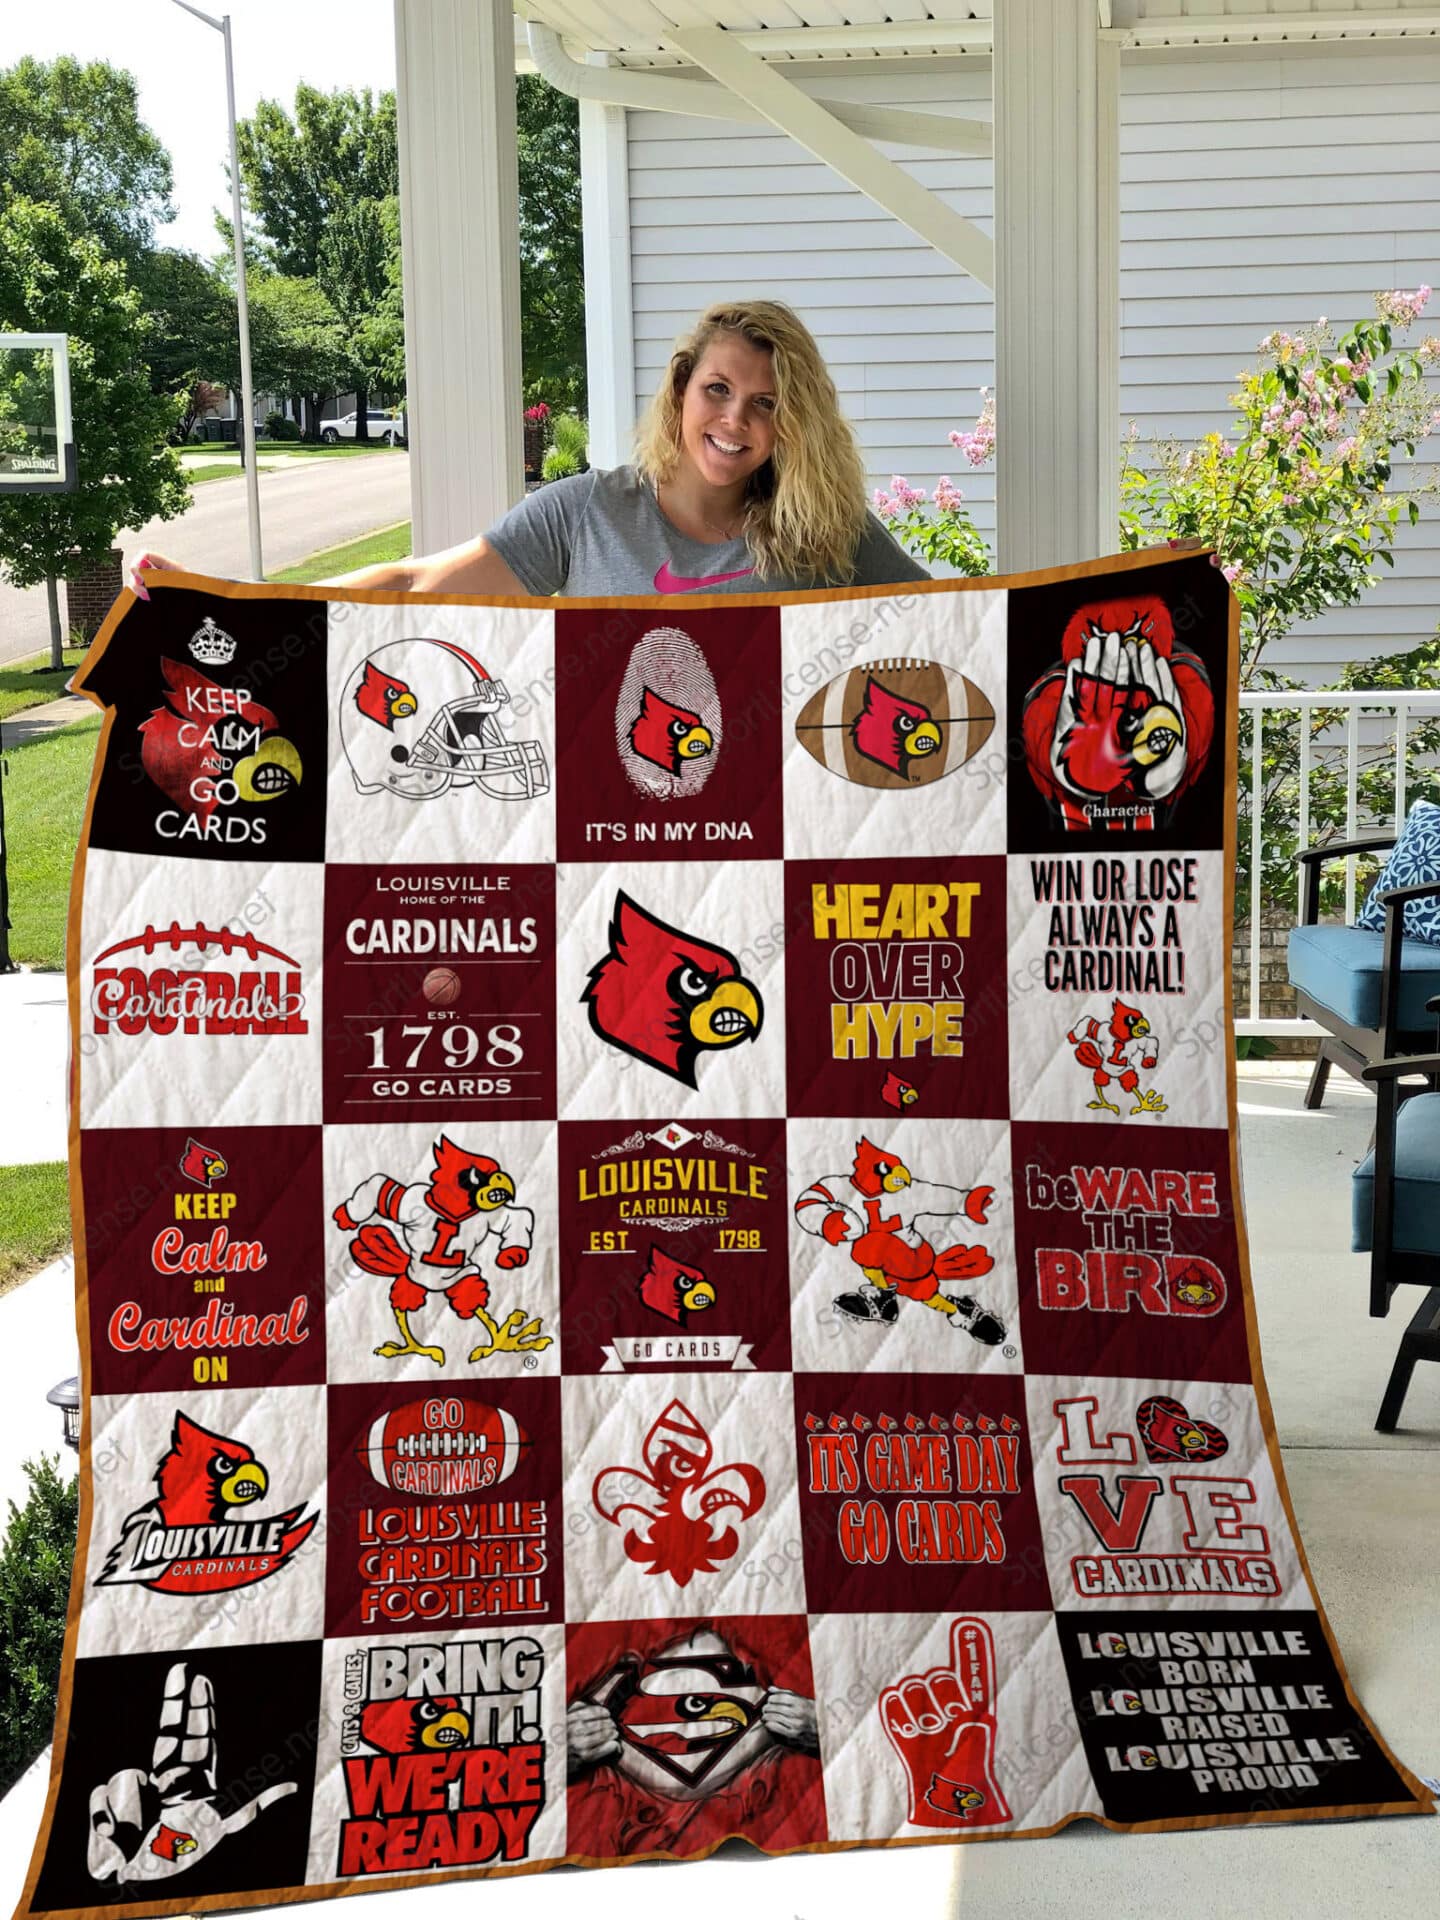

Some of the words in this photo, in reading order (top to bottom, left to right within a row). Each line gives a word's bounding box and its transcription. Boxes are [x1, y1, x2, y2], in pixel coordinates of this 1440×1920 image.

[11, 458, 57, 472] SPALDING
[185, 686, 252, 715] KEEP
[177, 722, 261, 752] CALM
[200, 757, 234, 771] AND
[189, 776, 240, 806] GO
[155, 810, 267, 845] CARDS
[1082, 803, 1156, 818] Character
[586, 822, 628, 842] IT'S
[634, 822, 657, 842] IN
[664, 822, 698, 842] MY
[704, 820, 754, 841] DNA
[376, 876, 511, 892] LOUISVILLE
[1030, 860, 1086, 903] WIN
[1092, 859, 1129, 903] OR
[1135, 858, 1200, 903] LOSE
[400, 896, 437, 905] HOME
[440, 896, 456, 904] OF
[460, 896, 486, 904] THE
[811, 882, 981, 940] HEART
[346, 917, 538, 955] CARDINALS
[1047, 905, 1157, 950] ALWAYS
[1162, 905, 1183, 949] A
[830, 941, 965, 1002] OVER
[1044, 950, 1187, 995] CARDINAL!
[90, 977, 306, 1023] Cardinals
[427, 1011, 460, 1020] EST.
[364, 1024, 524, 1069] 1798
[831, 1001, 965, 1060] HYPE
[372, 1080, 410, 1097] GO
[418, 1078, 512, 1096] CARDS
[578, 1157, 769, 1202] LOUISVILLE
[1026, 1164, 1220, 1217] beWARE
[174, 1192, 237, 1220] KEEP
[619, 1197, 728, 1218] CARDINALS
[151, 1225, 267, 1275] Calm
[590, 1230, 630, 1250] EST
[718, 1229, 761, 1249] 1798
[1082, 1211, 1174, 1254] THE
[193, 1276, 226, 1293] and
[1034, 1247, 1229, 1318] BIRD
[107, 1294, 310, 1352] Cardinal
[633, 1343, 654, 1358] GO
[665, 1341, 721, 1357] CARDS
[193, 1356, 229, 1384] ON
[423, 1397, 465, 1430] GO
[392, 1457, 497, 1496] CARDINALS
[806, 1433, 861, 1493] ITS
[864, 1433, 952, 1493] GAME
[953, 1435, 1022, 1494] DAY
[359, 1500, 548, 1546] LOUISVILLE
[837, 1500, 891, 1564] GO
[895, 1500, 1007, 1564] CARDS
[93, 1520, 286, 1583] LOUISVILLE
[171, 1559, 270, 1577] CARDINALS
[357, 1539, 549, 1585] CARDINALS
[1070, 1554, 1283, 1598] CARDINALS
[360, 1577, 550, 1624] FOOTBALL
[1077, 1631, 1312, 1660] LOUISVILLE
[367, 1636, 545, 1702] BRING
[1159, 1659, 1257, 1686] BORN
[1090, 1684, 1333, 1717] LOUISVILLE
[341, 1718, 361, 1755] CATS
[1160, 1713, 1291, 1741] RAISED
[1104, 1736, 1361, 1773] LOUISVILLE
[341, 1741, 546, 1820] WE'RE
[1191, 1764, 1319, 1794] PROUD
[336, 1803, 541, 1877] READY
